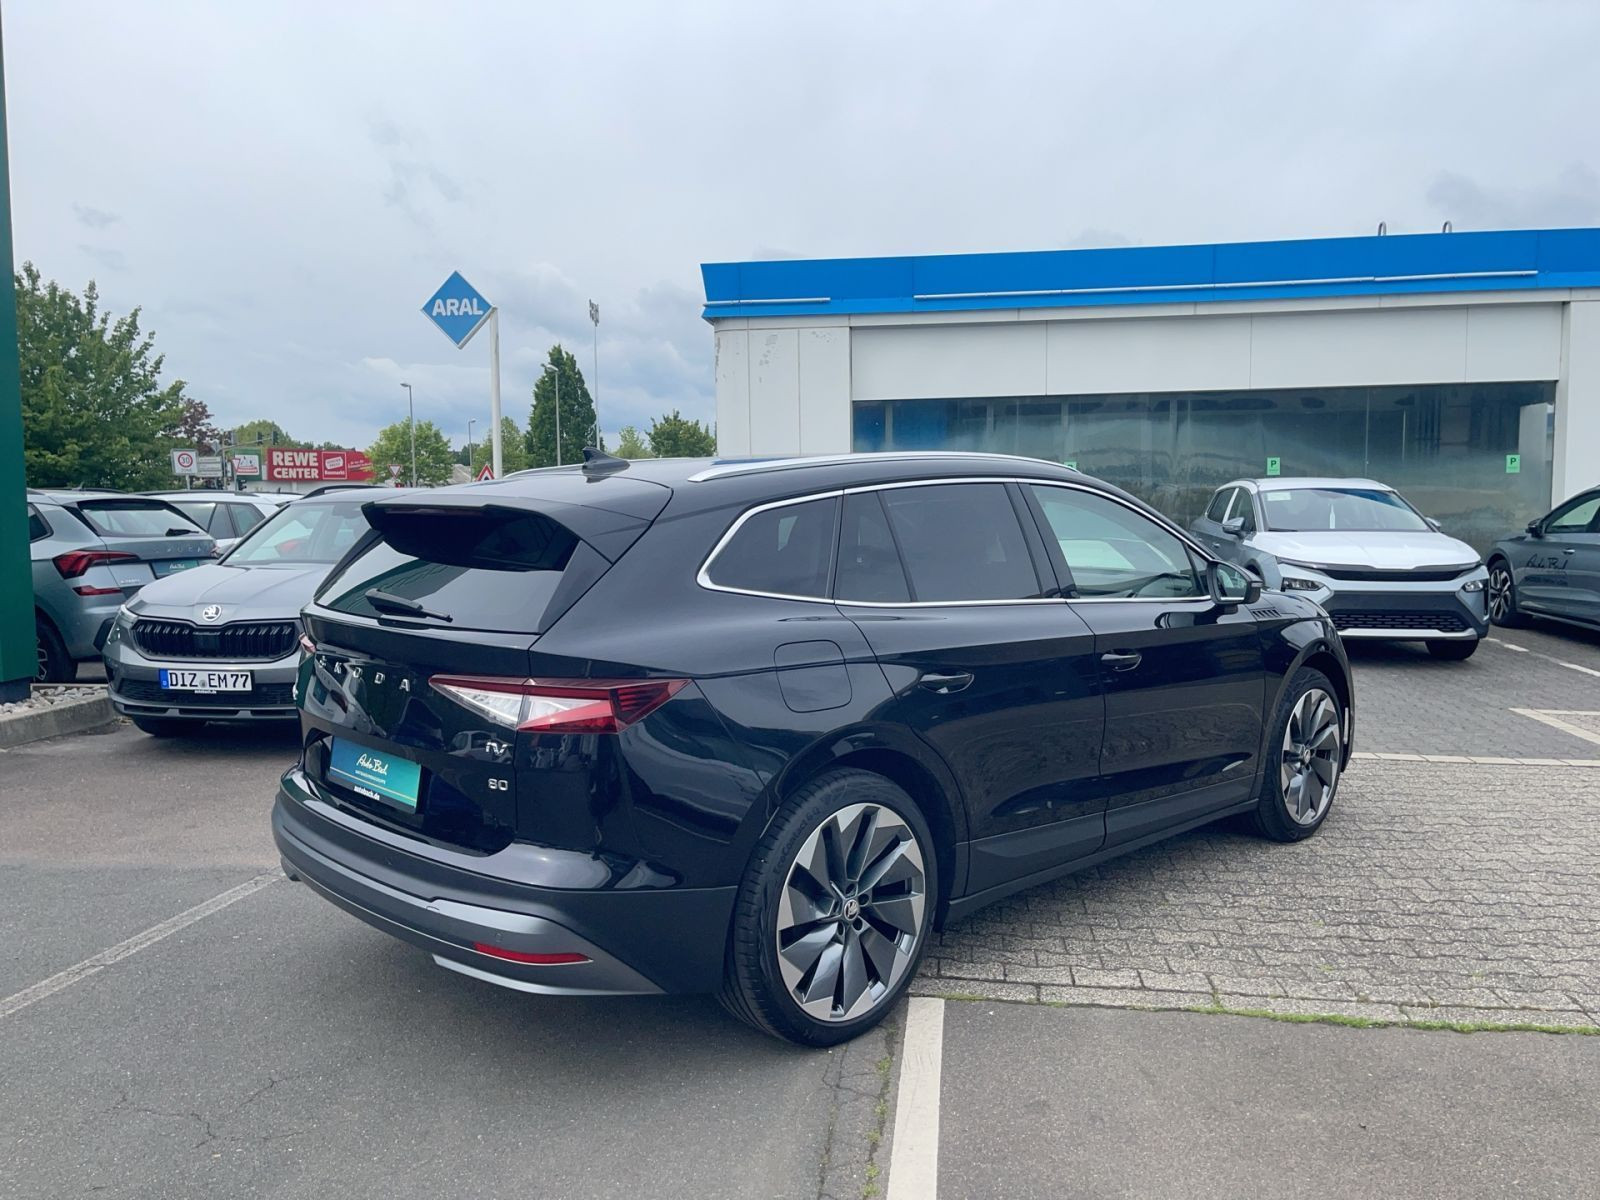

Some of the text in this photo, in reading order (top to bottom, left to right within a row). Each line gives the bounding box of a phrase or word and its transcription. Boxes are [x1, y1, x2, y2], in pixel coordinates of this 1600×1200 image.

[432, 297, 484, 317] ARAL
[181, 456, 190, 465] 30
[272, 451, 319, 466] REWE
[273, 468, 319, 479] CENTER
[169, 672, 198, 688] DIZ
